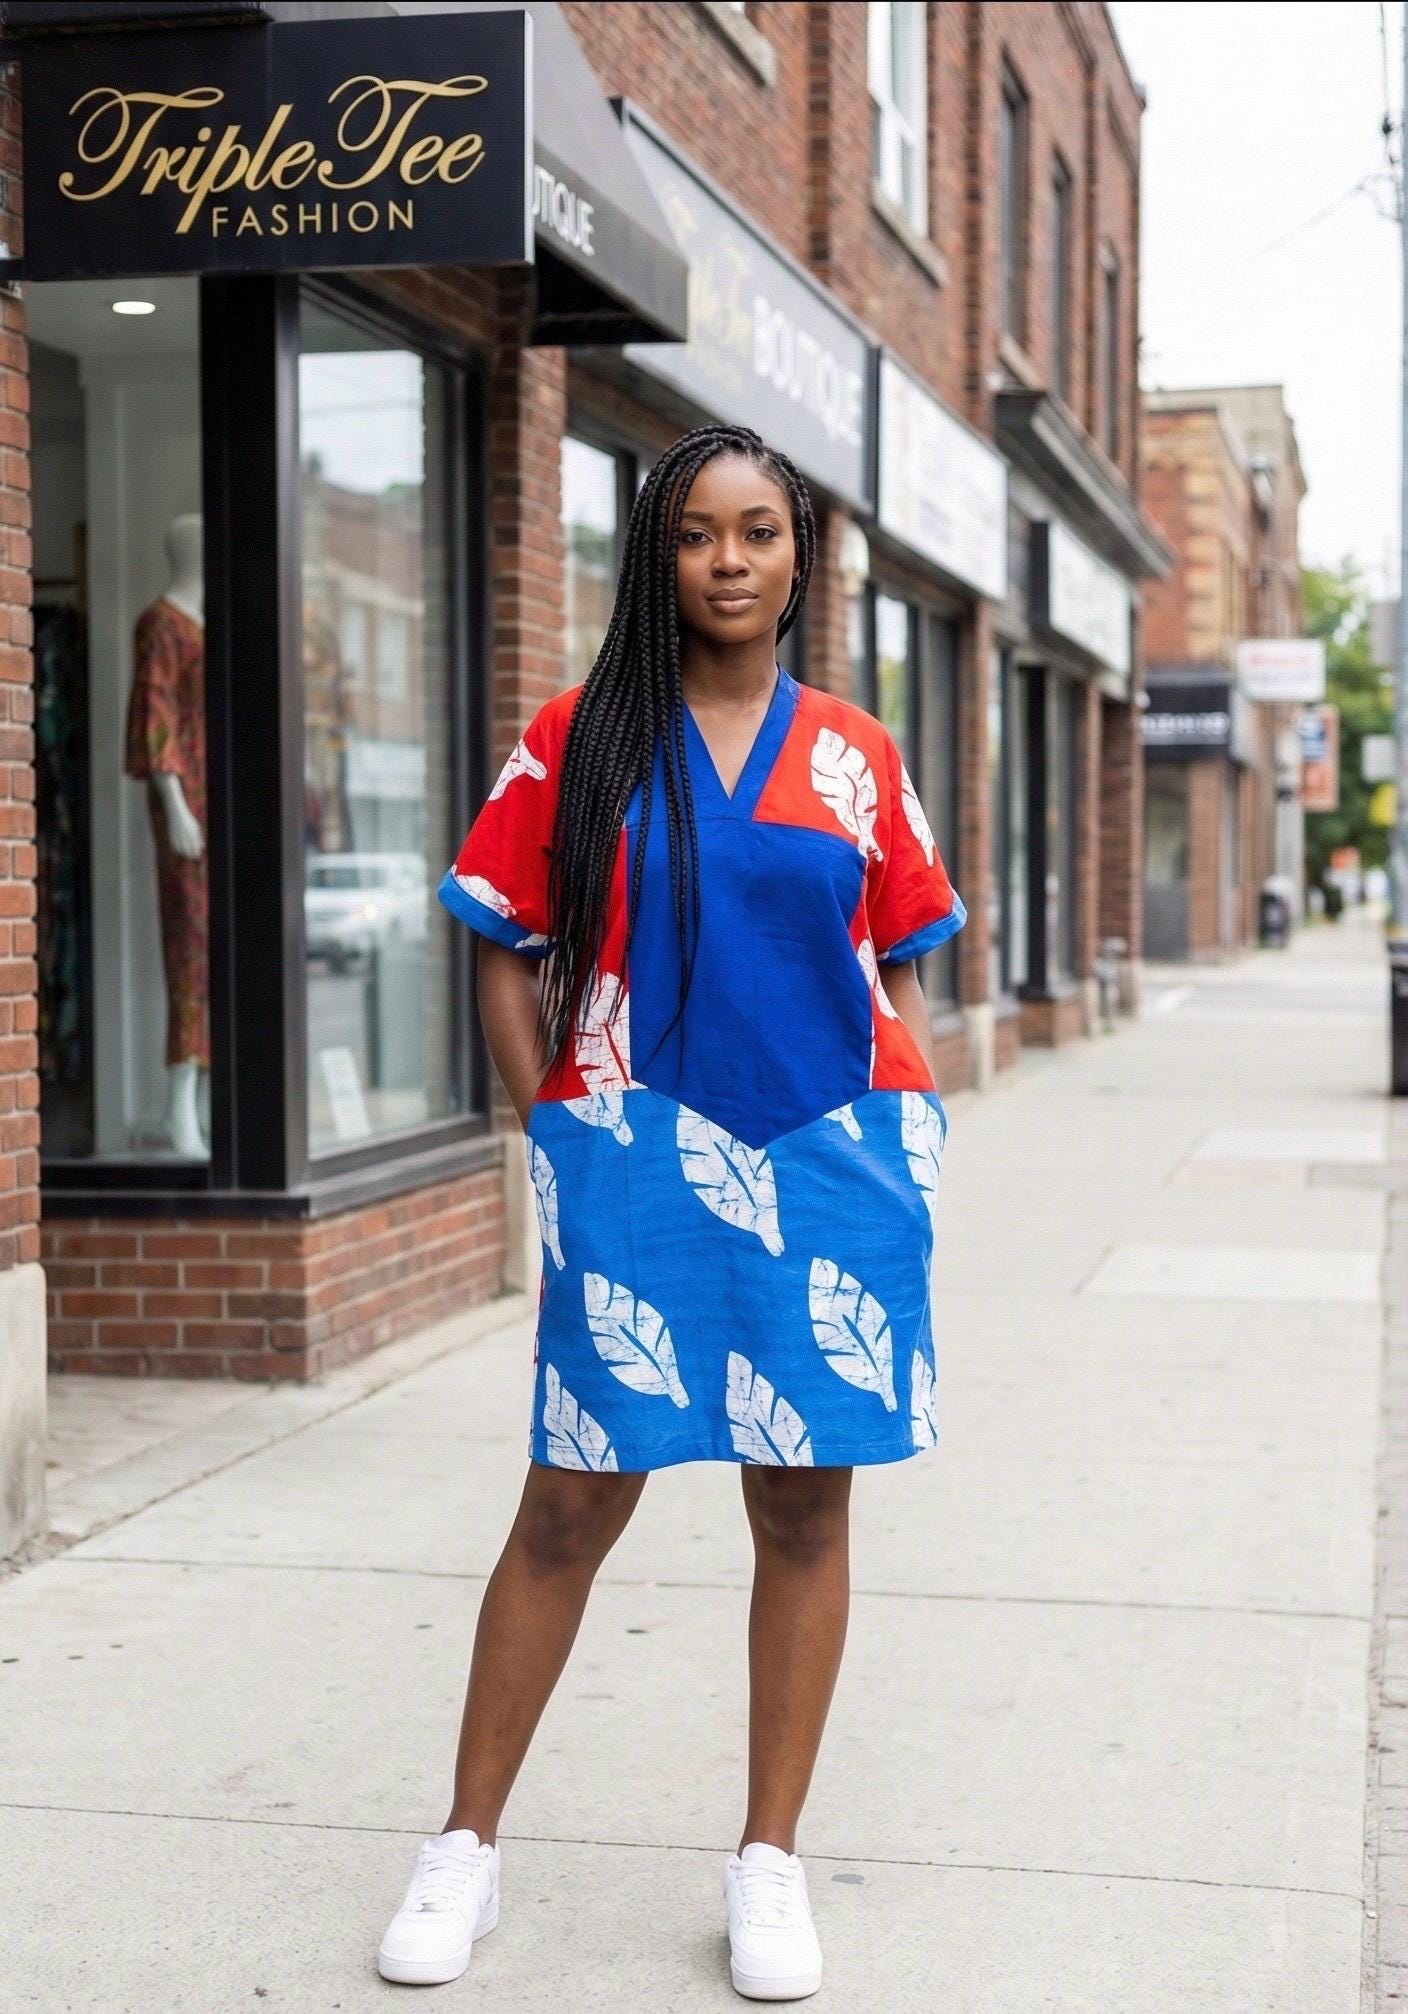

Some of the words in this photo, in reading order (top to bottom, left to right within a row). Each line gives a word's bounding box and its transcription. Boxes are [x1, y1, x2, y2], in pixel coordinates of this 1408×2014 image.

[58, 86, 317, 234] Triple
[317, 74, 489, 190] Tee
[212, 199, 414, 238] FASHION
[753, 296, 863, 446] BOUTIQUE
